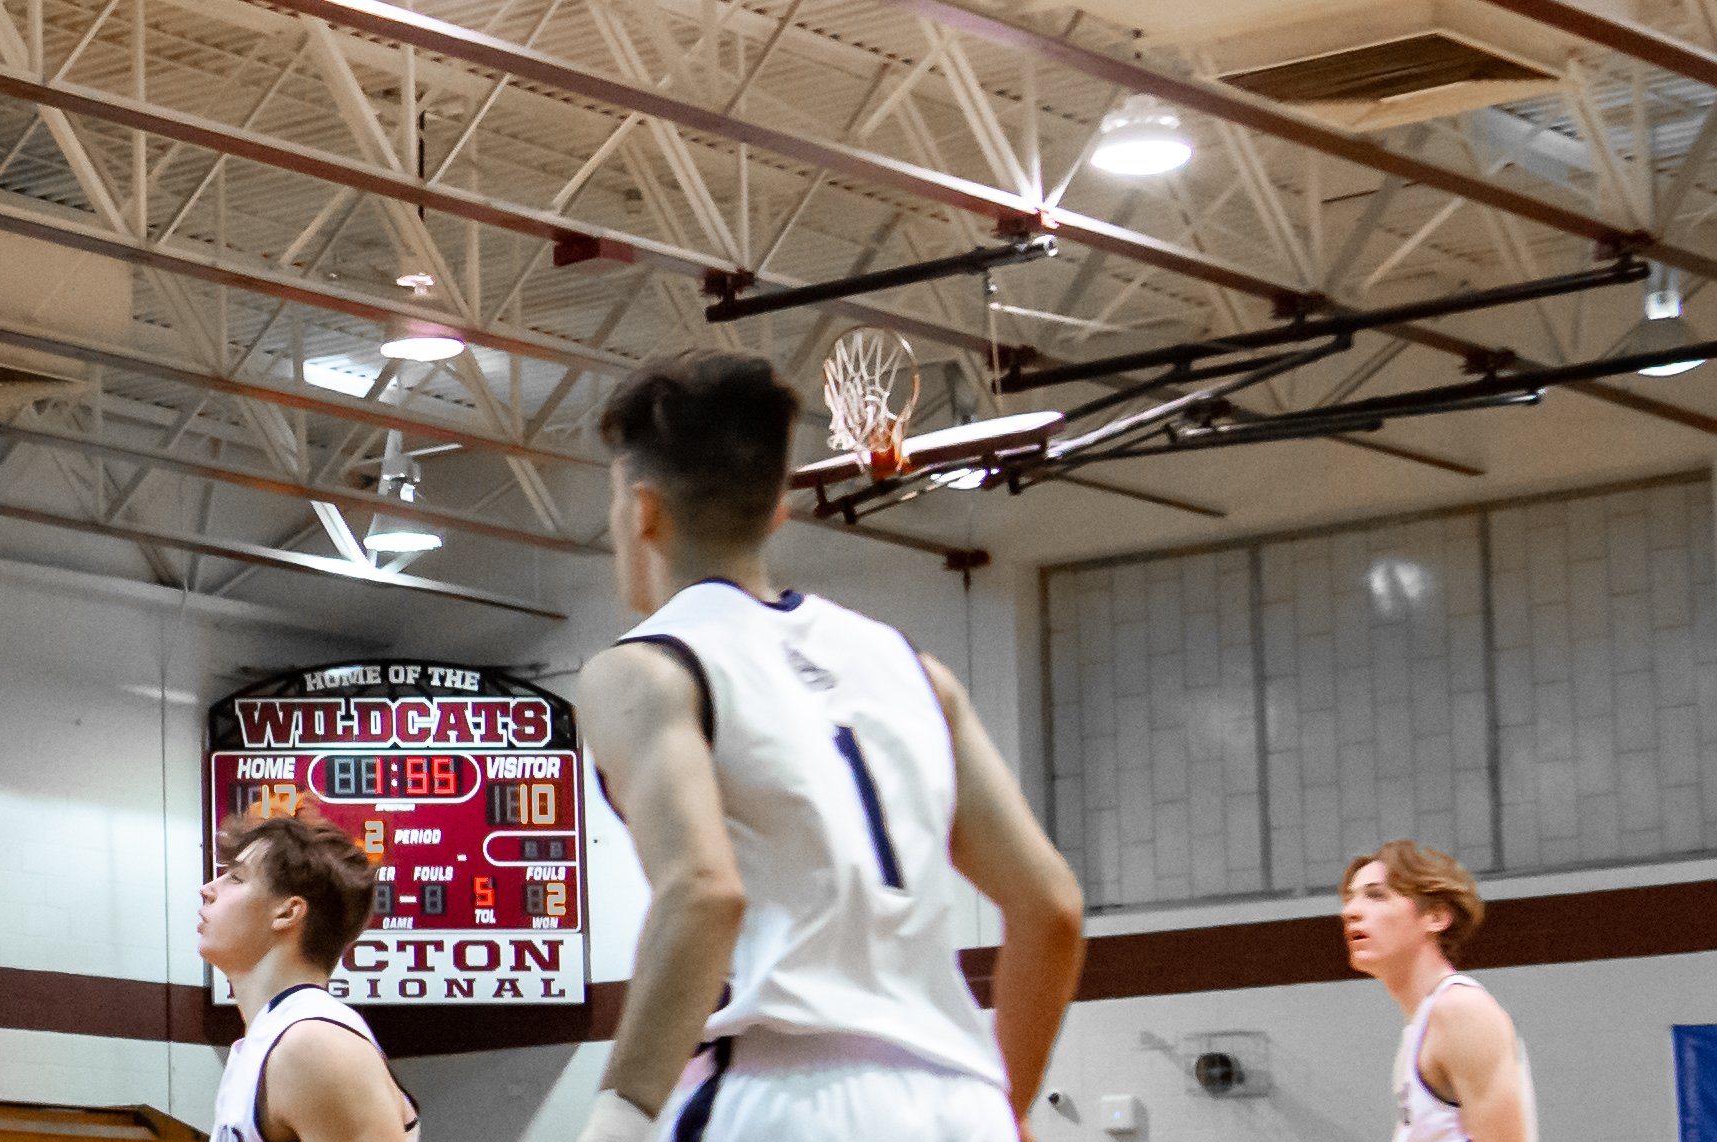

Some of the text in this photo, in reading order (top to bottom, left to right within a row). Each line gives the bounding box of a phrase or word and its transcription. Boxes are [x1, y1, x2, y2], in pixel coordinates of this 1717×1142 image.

[304, 665, 481, 692] HOME OF THE
[235, 696, 552, 748] WILDCATS
[237, 757, 296, 779] HOME
[486, 757, 561, 779] VISITOR
[833, 725, 905, 889] 1
[364, 821, 384, 853] 2
[394, 829, 442, 845] PERIOD
[413, 866, 455, 882] FOULS
[526, 866, 567, 881] FOULS
[474, 876, 495, 907] 5
[546, 882, 567, 916] 2
[382, 917, 415, 930] GAME
[475, 909, 497, 924] TOL
[532, 917, 559, 929] WON
